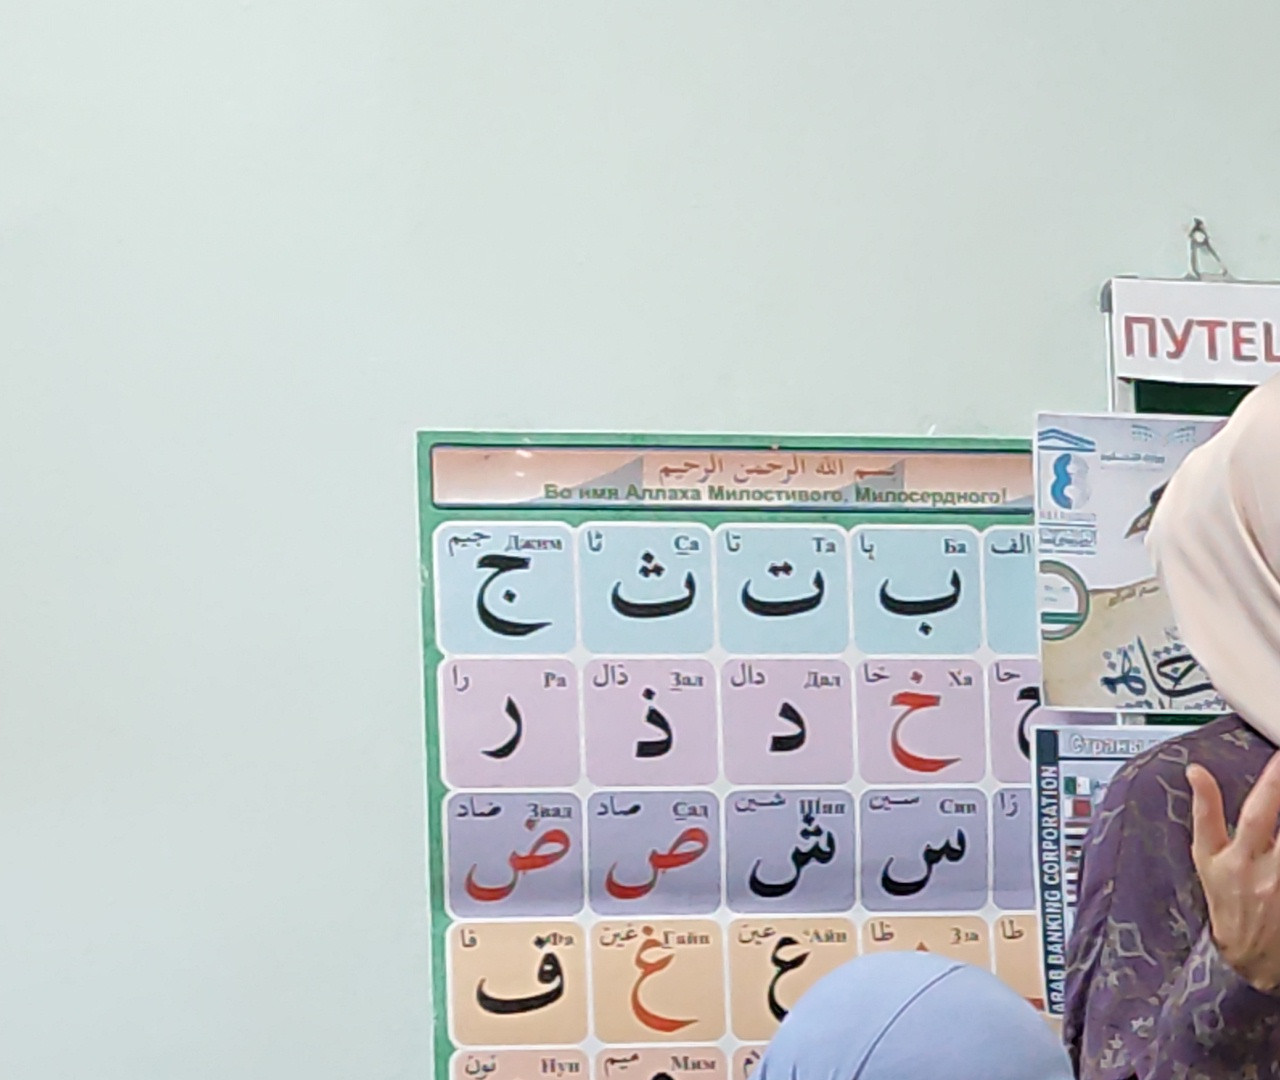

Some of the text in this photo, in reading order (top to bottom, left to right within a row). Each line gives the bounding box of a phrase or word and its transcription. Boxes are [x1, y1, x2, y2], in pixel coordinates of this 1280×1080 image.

[579, 487, 620, 500] имя
[625, 484, 701, 501] Аллаха
[812, 536, 836, 553] Та
[944, 538, 967, 554] Ба
[477, 554, 552, 637] ج
[612, 552, 697, 618] ث
[741, 562, 824, 616] ت
[879, 569, 961, 635] ب
[543, 672, 567, 688] Ра
[480, 696, 522, 759] ر
[635, 687, 673, 757] ذ
[769, 702, 806, 752] د
[1041, 765, 1060, 884] CORPORATION
[605, 828, 709, 899] ص
[881, 828, 966, 896] س
